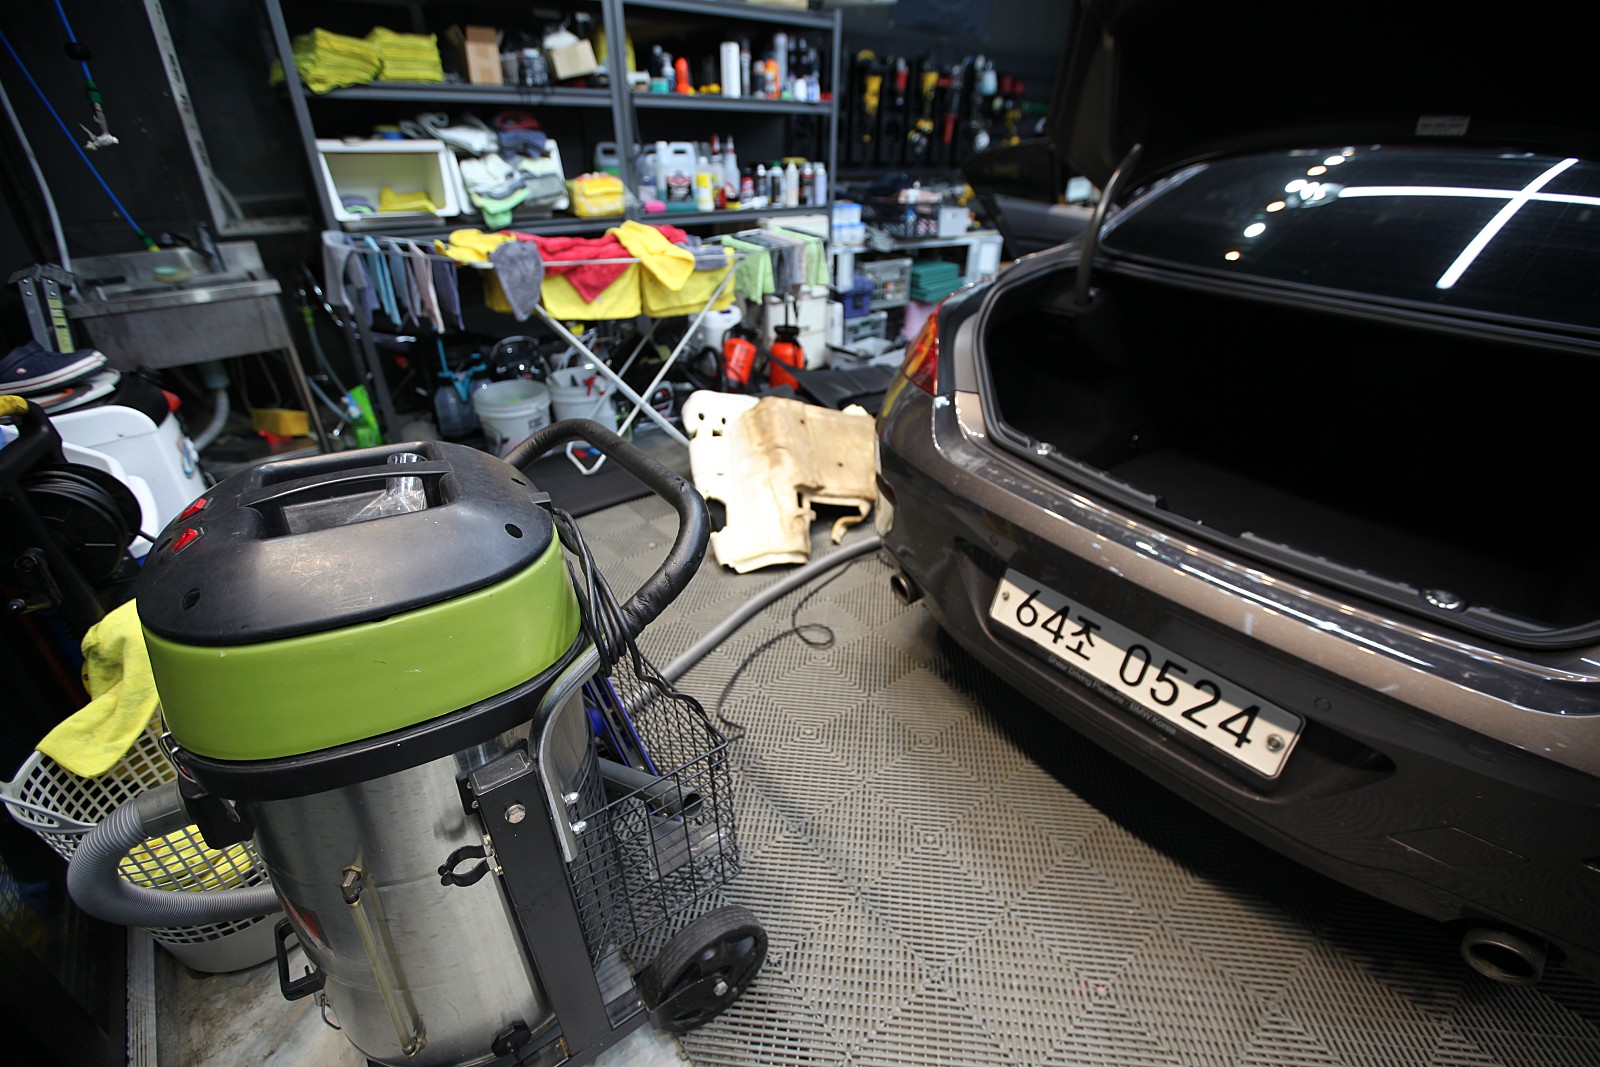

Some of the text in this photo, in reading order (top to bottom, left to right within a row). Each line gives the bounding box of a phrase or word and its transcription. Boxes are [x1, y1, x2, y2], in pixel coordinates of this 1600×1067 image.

[1016, 590, 1261, 747] 64조 0524
[1068, 667, 1092, 686] Driving
[1092, 679, 1124, 704] Pleasure
[1129, 703, 1152, 720] BMW
[1152, 716, 1177, 735] Korea
